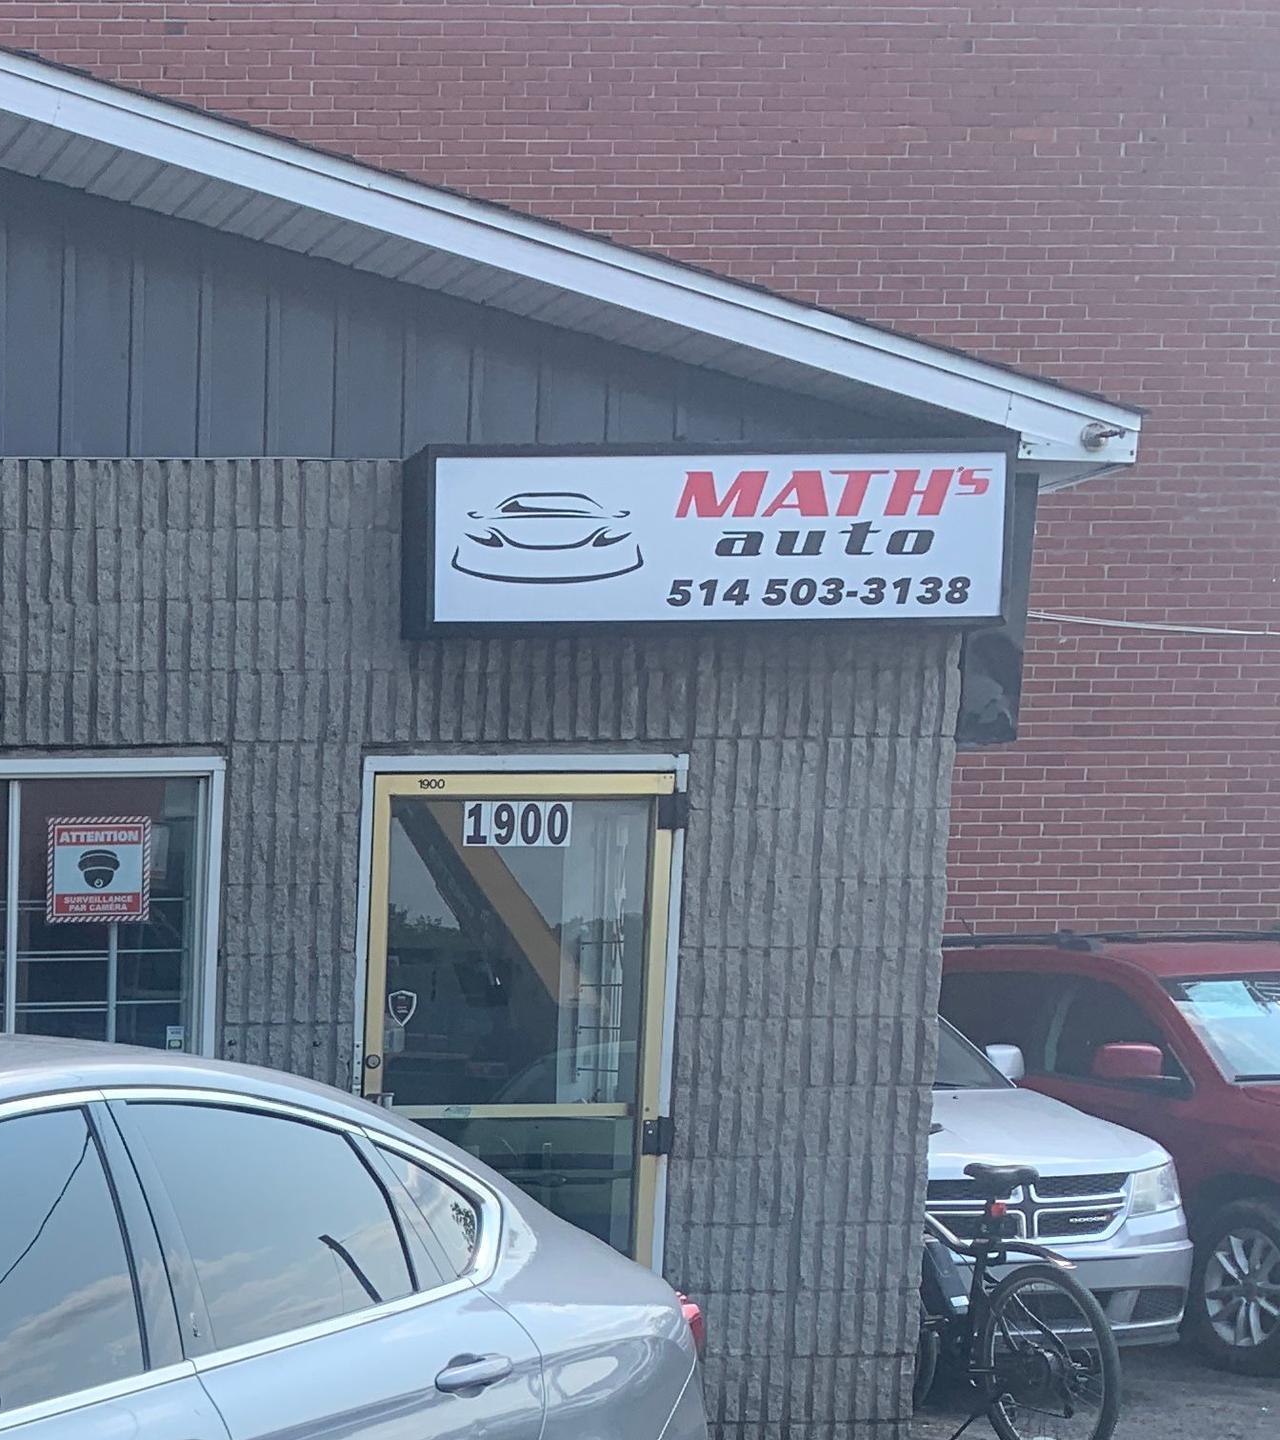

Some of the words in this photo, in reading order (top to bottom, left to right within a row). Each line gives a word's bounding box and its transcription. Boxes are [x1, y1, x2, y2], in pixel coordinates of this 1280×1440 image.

[714, 521, 935, 557] auto
[666, 578, 750, 606] 514
[761, 576, 971, 606] 503-3138
[418, 778, 446, 790] 1900
[466, 803, 569, 845] 1900
[59, 830, 139, 843] ATTENTION
[63, 895, 133, 904] SURVEILLANCE
[68, 904, 87, 912] PAR
